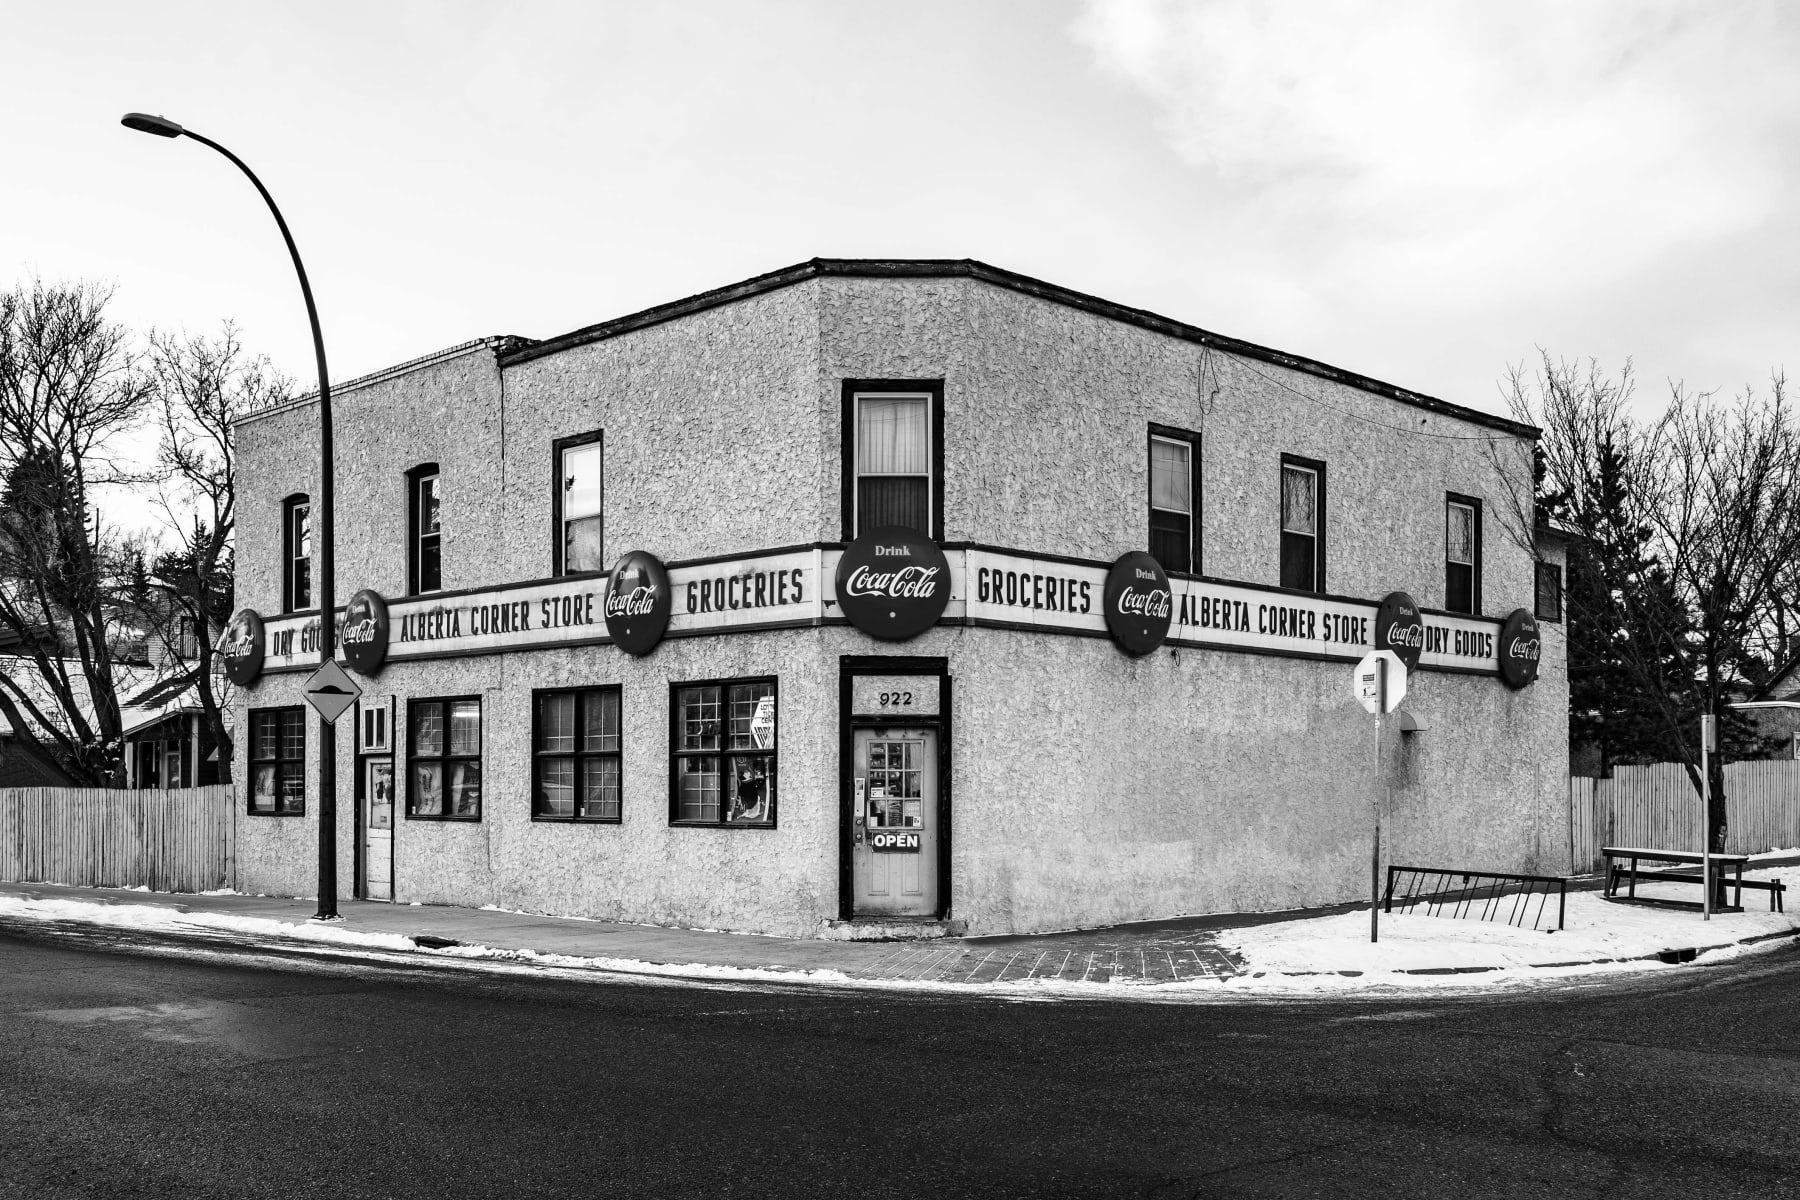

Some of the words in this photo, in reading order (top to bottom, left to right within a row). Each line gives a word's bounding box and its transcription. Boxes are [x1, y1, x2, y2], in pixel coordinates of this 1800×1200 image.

[874, 544, 911, 557] Drink
[619, 568, 639, 580] Drink
[846, 564, 941, 598] Coca-Cola
[1135, 568, 1157, 581] Drink
[606, 585, 657, 618] Coca-Cola
[687, 568, 803, 614] GROCERIES
[978, 567, 1091, 614] GROCERIES
[1118, 586, 1170, 618] Coca-Cola
[401, 609, 461, 642] ALBERTA
[471, 601, 530, 635] CORNER
[541, 593, 594, 628] STORE
[1179, 594, 1250, 632] ALBERTA
[1259, 604, 1316, 639] CORNER
[1323, 613, 1368, 645] STORE
[1400, 606, 1413, 616] Drink
[273, 628, 294, 656] DRY
[342, 618, 377, 645] Coca-Cola
[1387, 621, 1423, 648] Coca-Cola
[1426, 625, 1449, 654] DRY
[1455, 629, 1492, 658] GOODS
[880, 691, 912, 706] 922
[874, 834, 918, 848] OPEN
